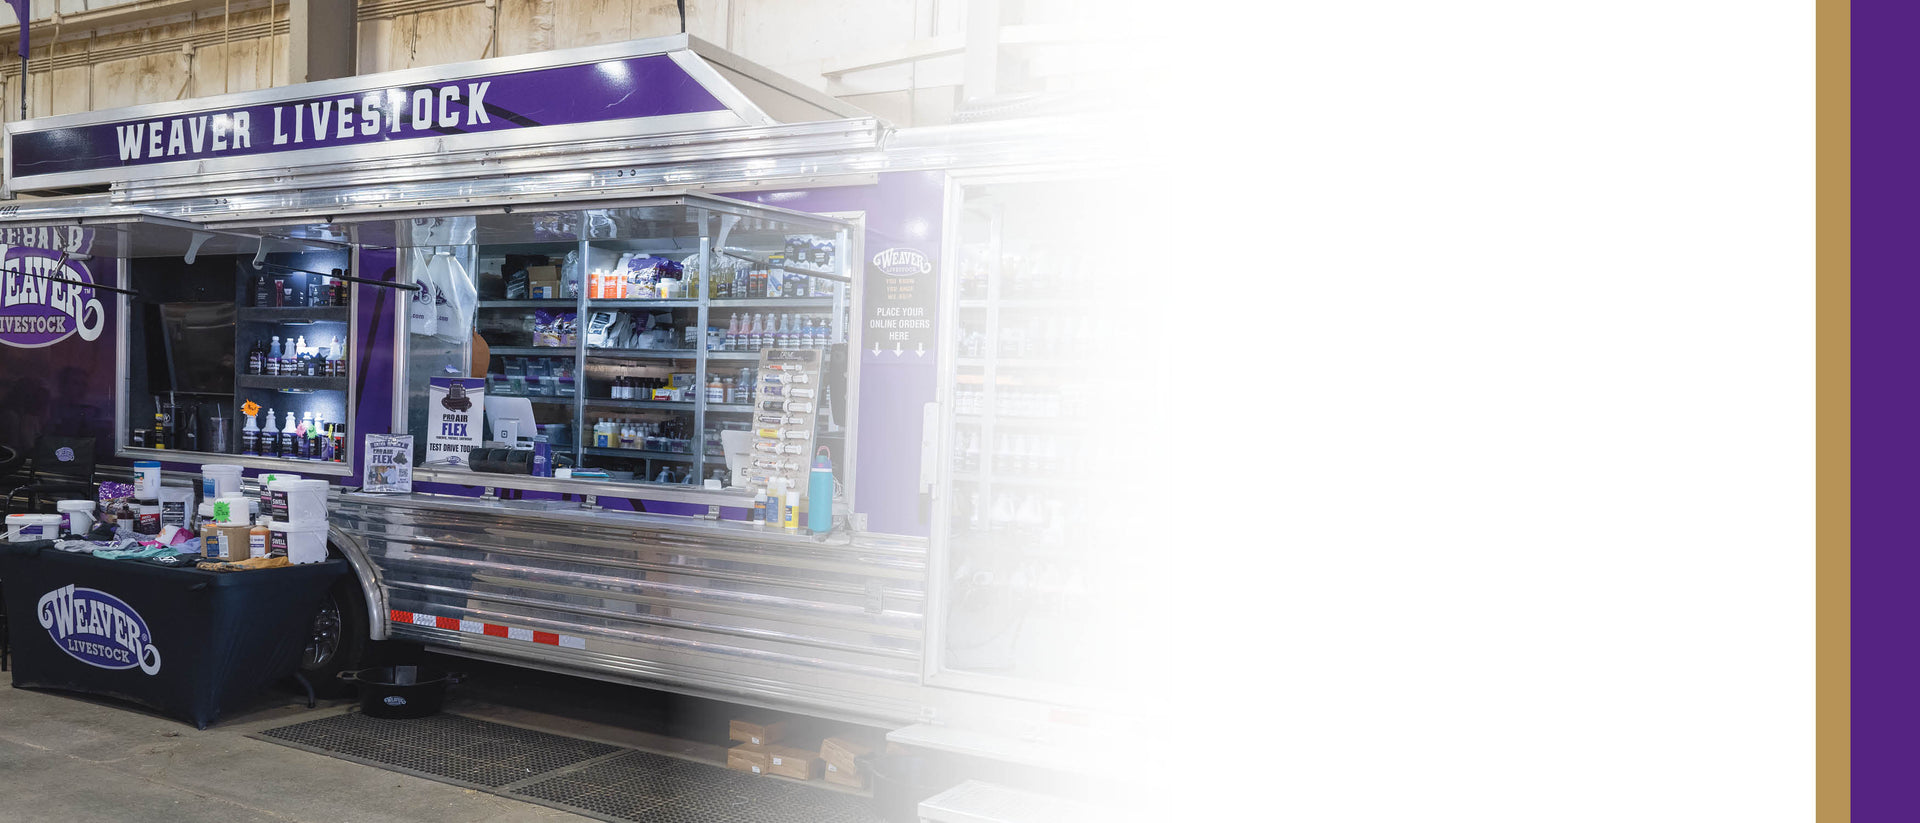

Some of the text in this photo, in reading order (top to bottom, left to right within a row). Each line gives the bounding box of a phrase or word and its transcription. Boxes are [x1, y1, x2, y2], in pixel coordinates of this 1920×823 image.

[116, 81, 491, 162] WEAVER LIVESTOCK
[873, 247, 931, 273] WEAVER
[0, 244, 105, 341] EAVER
[876, 307, 924, 317] PLACE YOUR
[0, 315, 66, 333] IVESTOCK
[869, 319, 930, 329] ONLINE ORDERS
[888, 331, 909, 341] HERE
[441, 422, 468, 437] FLEX
[429, 443, 442, 452] TEST
[443, 443, 460, 453] DRIVE
[372, 455, 393, 465] FLEX
[272, 498, 287, 507] SWELL
[271, 538, 286, 546] SWELL
[38, 584, 161, 675] WEAVER
[67, 638, 130, 663] LIVESTOCK
